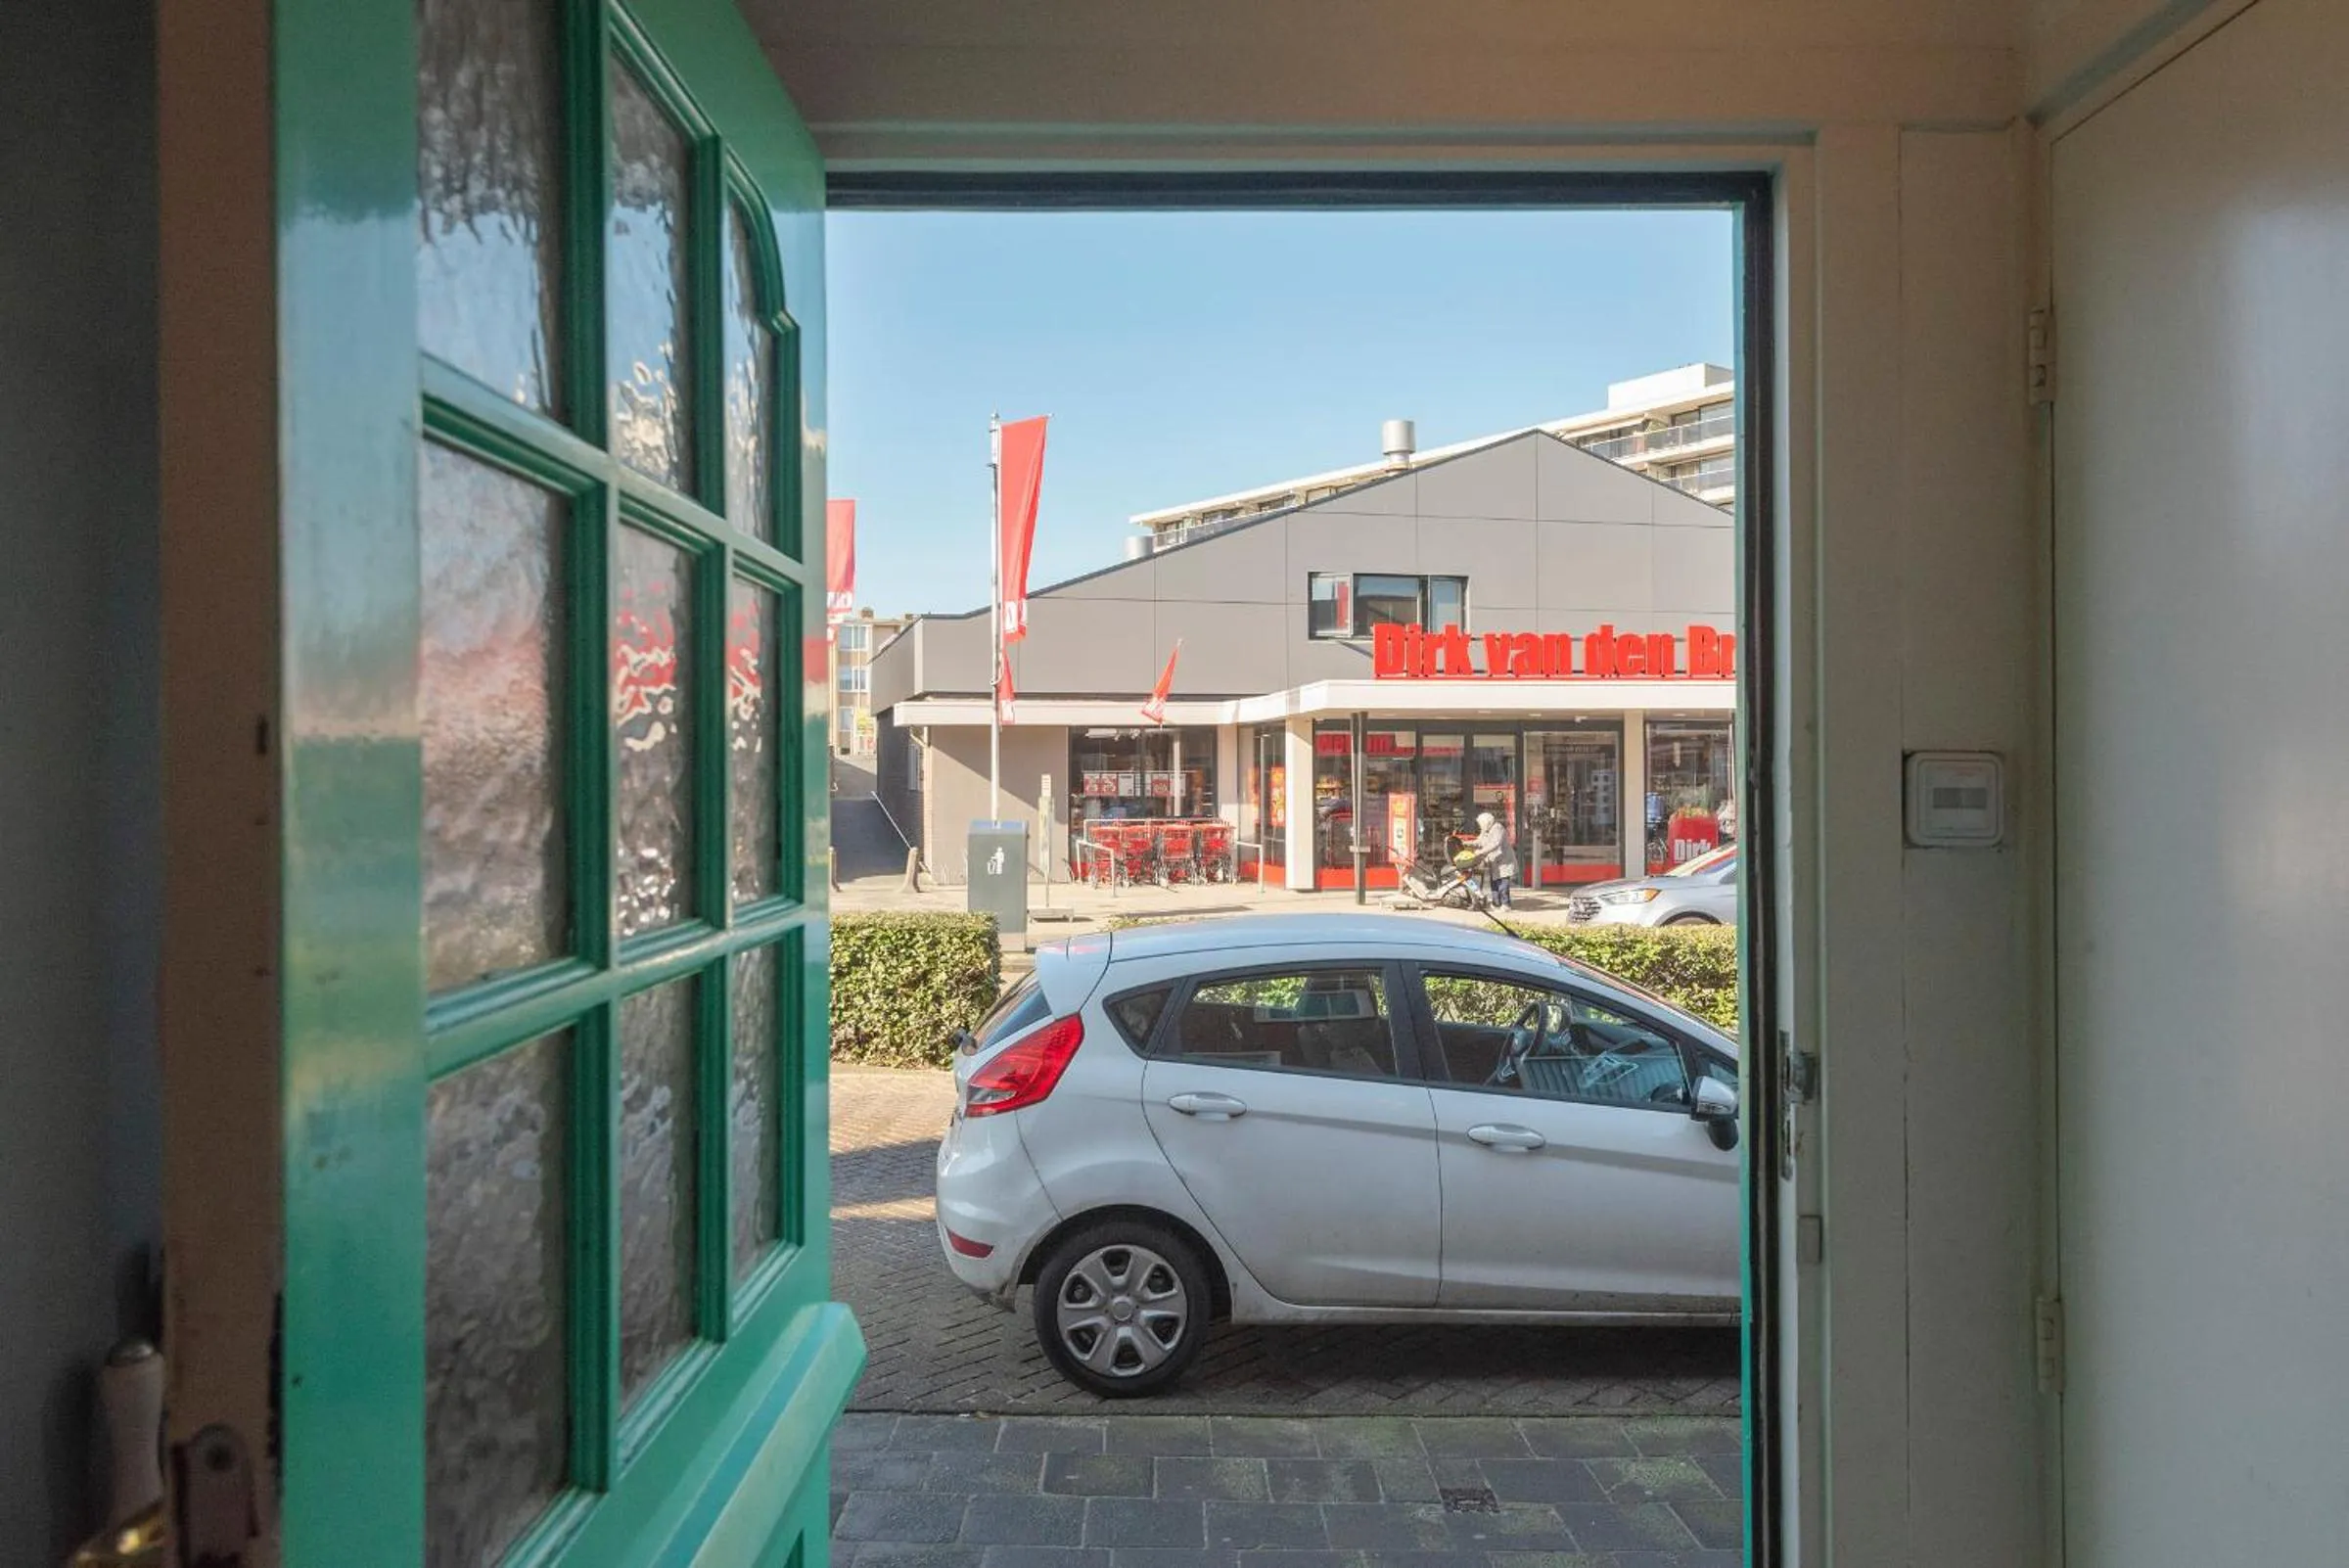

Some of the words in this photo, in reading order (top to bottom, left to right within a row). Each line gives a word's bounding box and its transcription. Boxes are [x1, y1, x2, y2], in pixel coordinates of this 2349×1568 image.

[1372, 623, 1474, 677] Dirk
[1483, 631, 1573, 677] van
[1584, 623, 1676, 677] den
